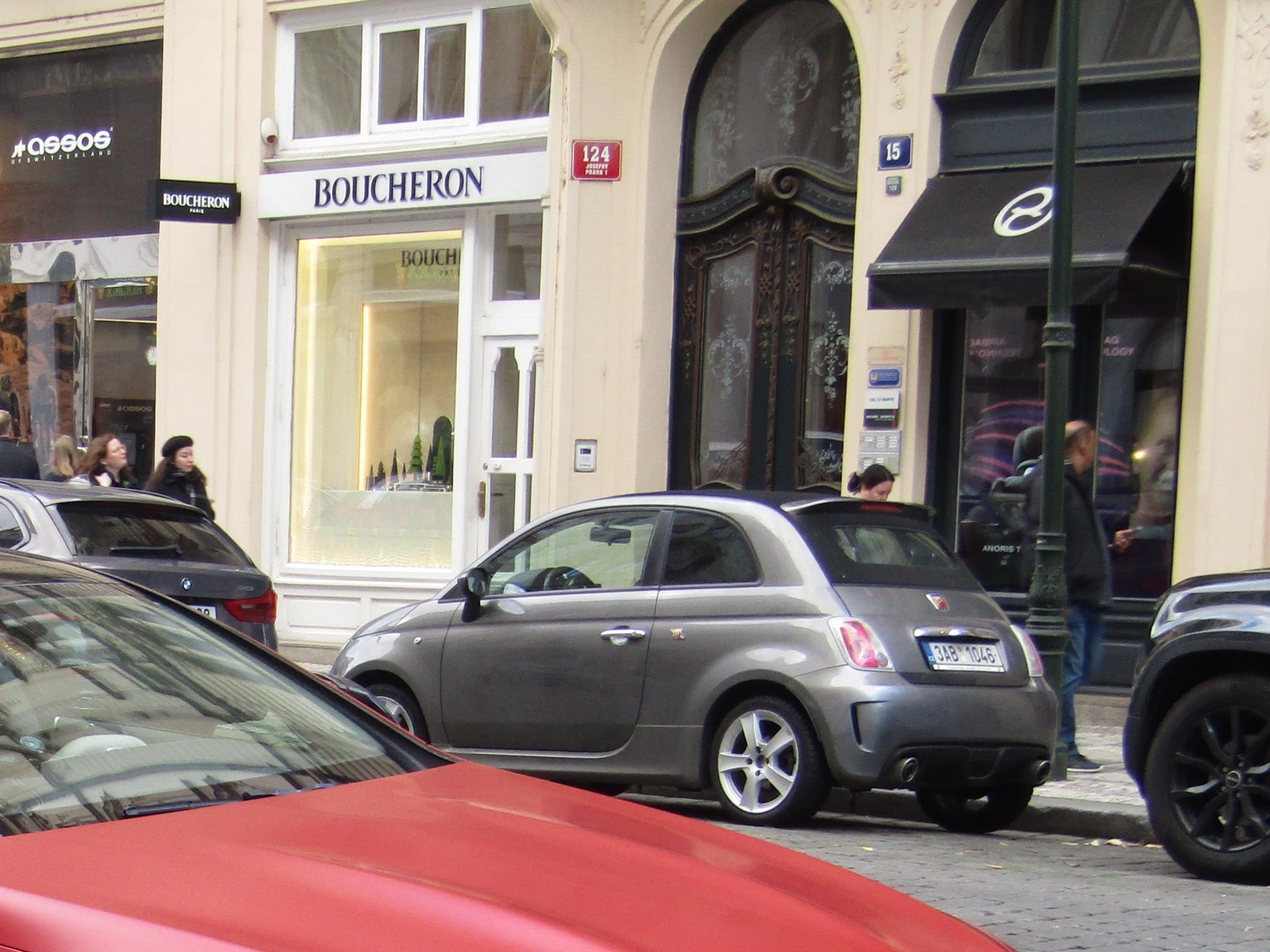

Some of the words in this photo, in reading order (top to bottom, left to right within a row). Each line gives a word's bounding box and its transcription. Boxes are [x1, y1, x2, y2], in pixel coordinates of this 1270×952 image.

[27, 130, 111, 157] assos
[886, 142, 901, 161] 15
[26, 149, 112, 164] SWITZERLAND
[583, 145, 610, 163] 124
[313, 166, 485, 209] BOUCHERON
[162, 192, 230, 209] BOUCHERON
[934, 645, 959, 662] 3AB
[965, 646, 996, 664] 1046
